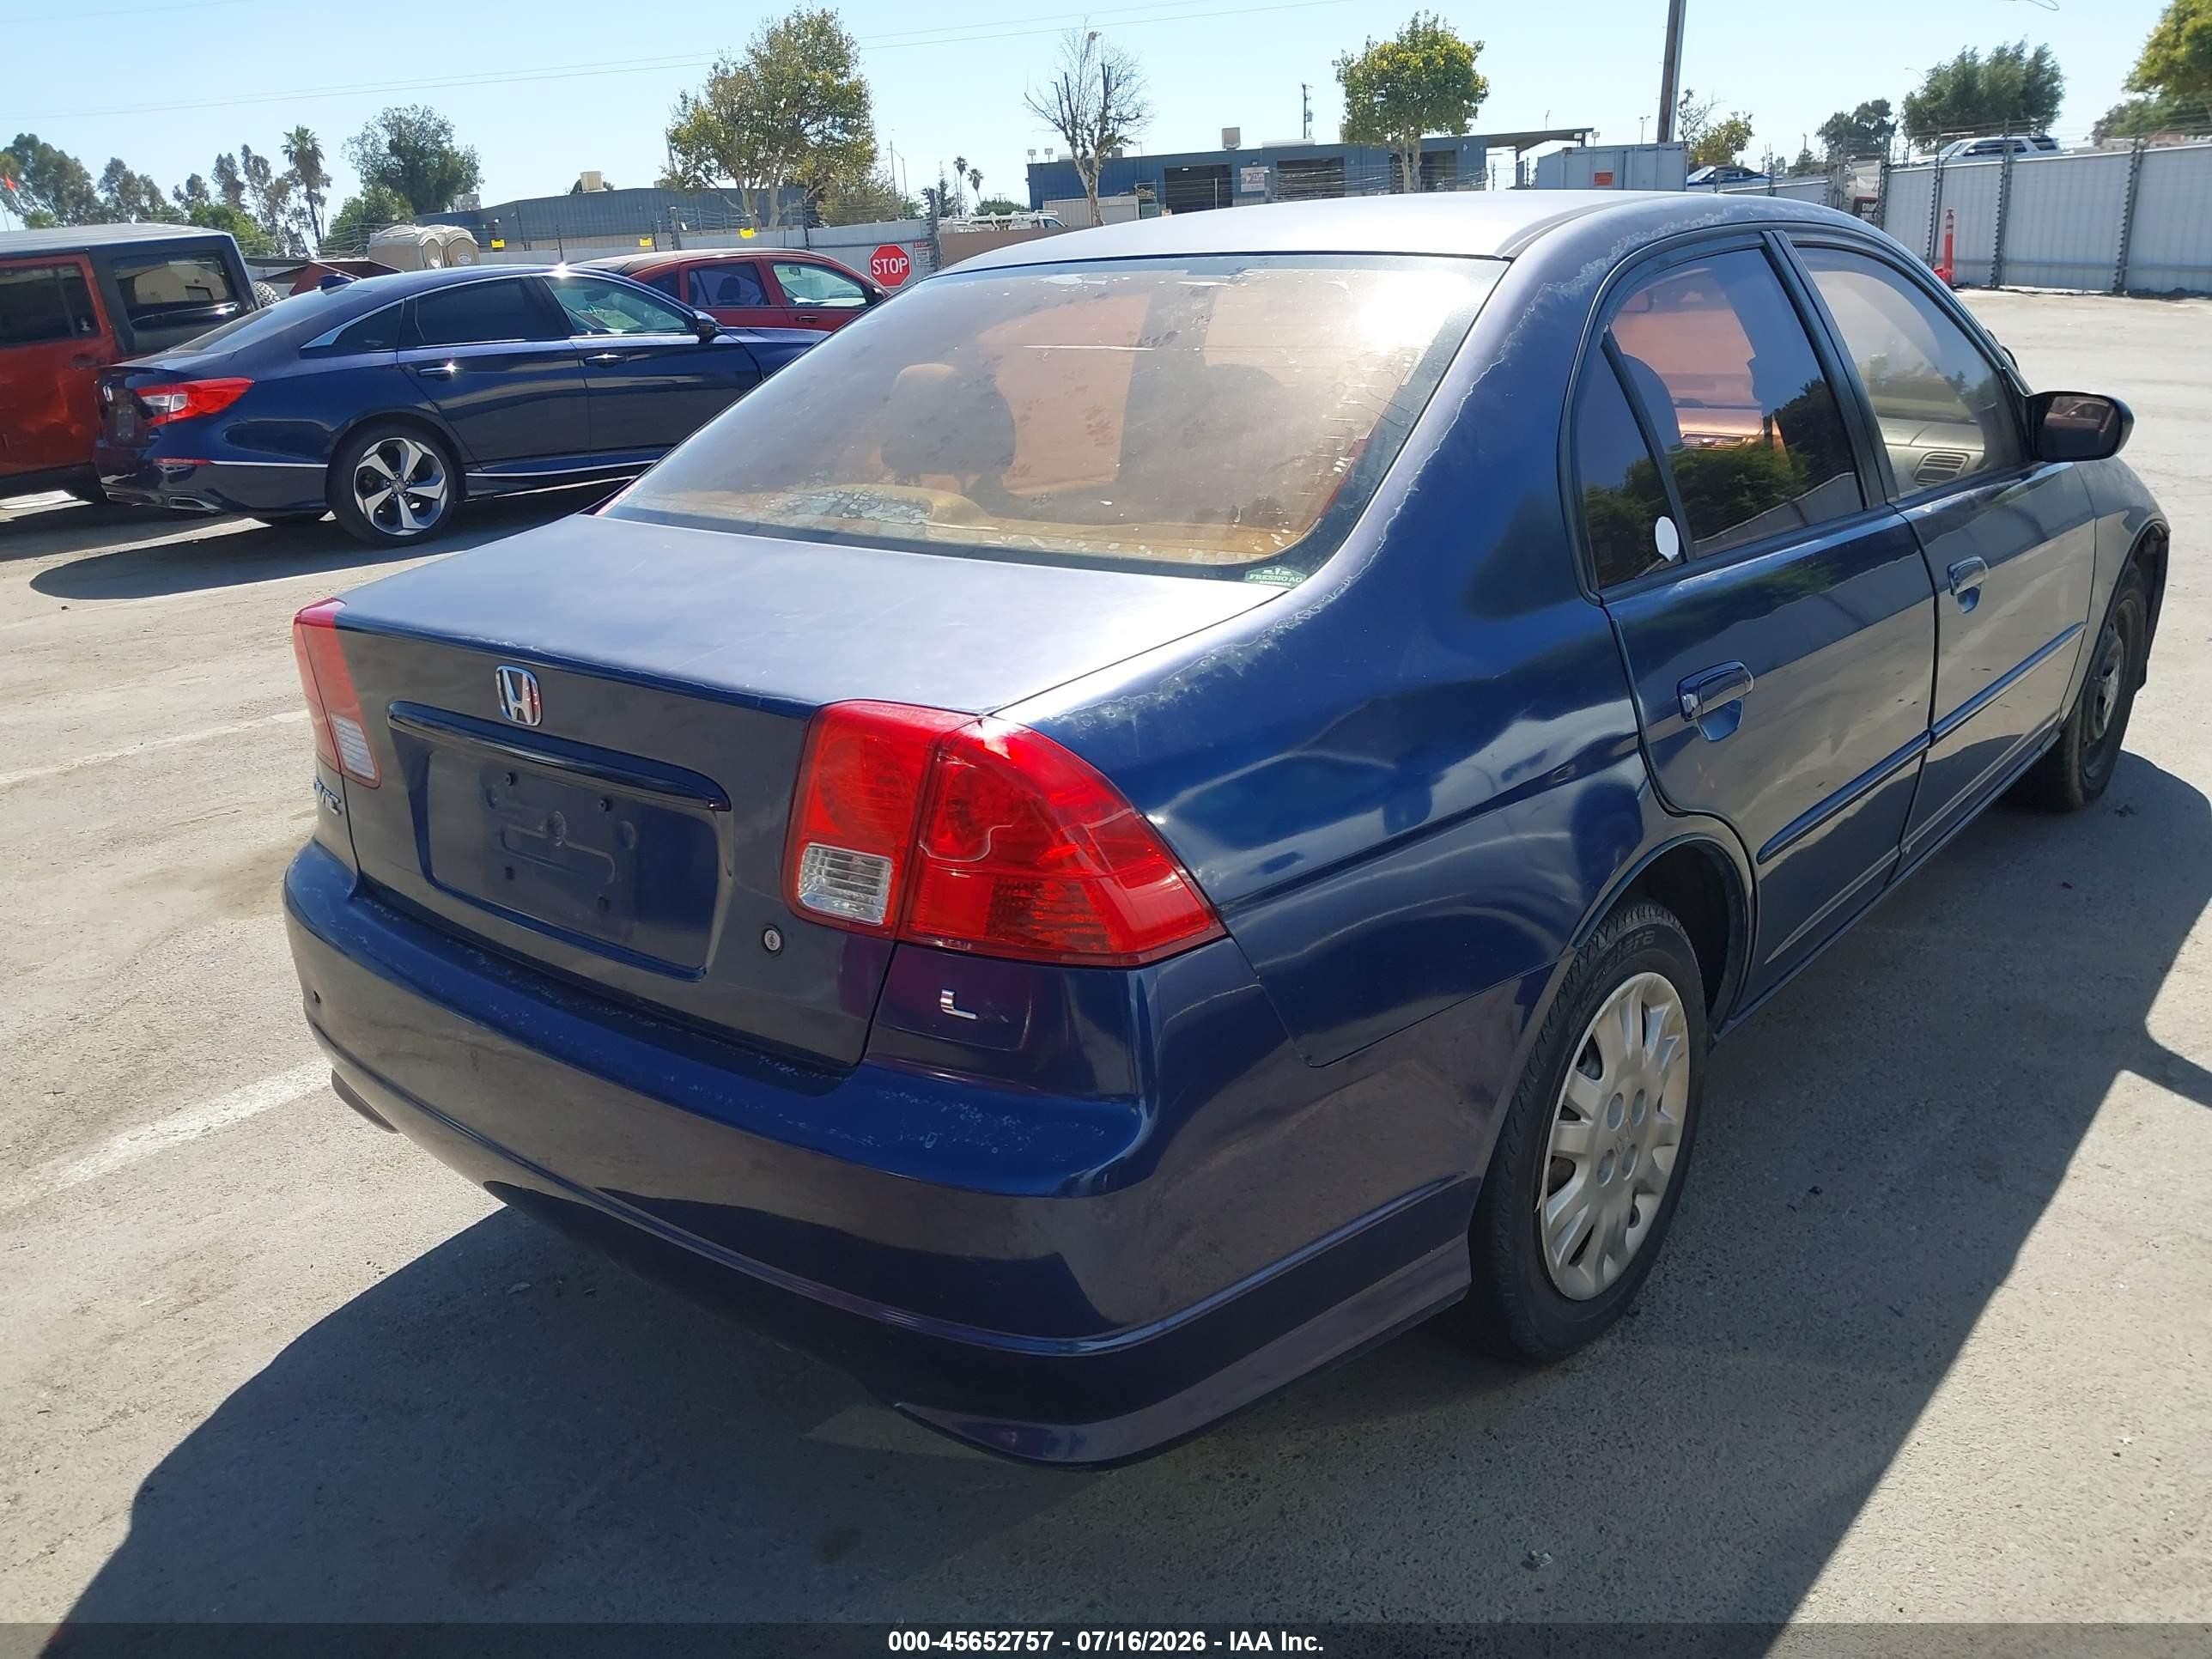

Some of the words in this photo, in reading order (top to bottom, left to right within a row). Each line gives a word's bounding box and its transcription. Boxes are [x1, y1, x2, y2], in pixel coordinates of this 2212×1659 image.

[872, 258, 908, 275] STOP
[1249, 574, 1287, 582] FRESNO
[940, 989, 977, 1019] L
